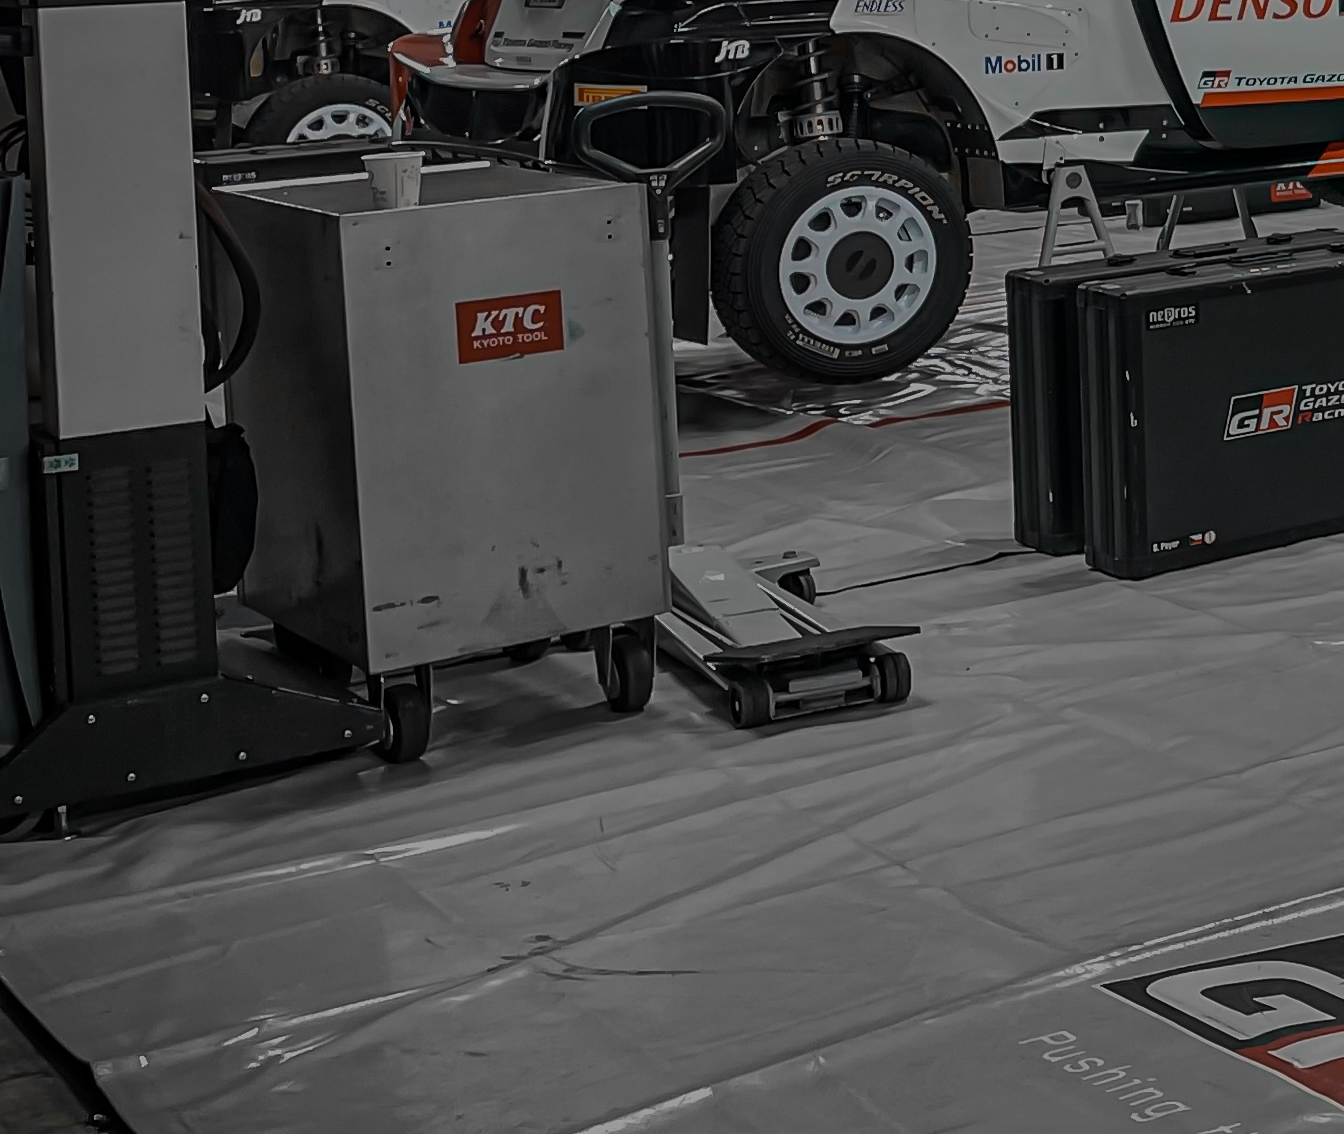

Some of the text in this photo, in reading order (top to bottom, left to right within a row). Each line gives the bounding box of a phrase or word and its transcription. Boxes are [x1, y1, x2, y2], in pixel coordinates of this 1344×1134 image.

[854, 0, 906, 14] ENDLESS
[984, 53, 1063, 75] Mobil 1
[1199, 77, 1230, 89] GR
[1234, 75, 1299, 87] TOYOTA
[470, 303, 546, 338] KTC
[473, 330, 549, 350] KYOTO TOOL
[1228, 403, 1291, 436] GR
[1017, 1029, 1193, 1123] Pushing
